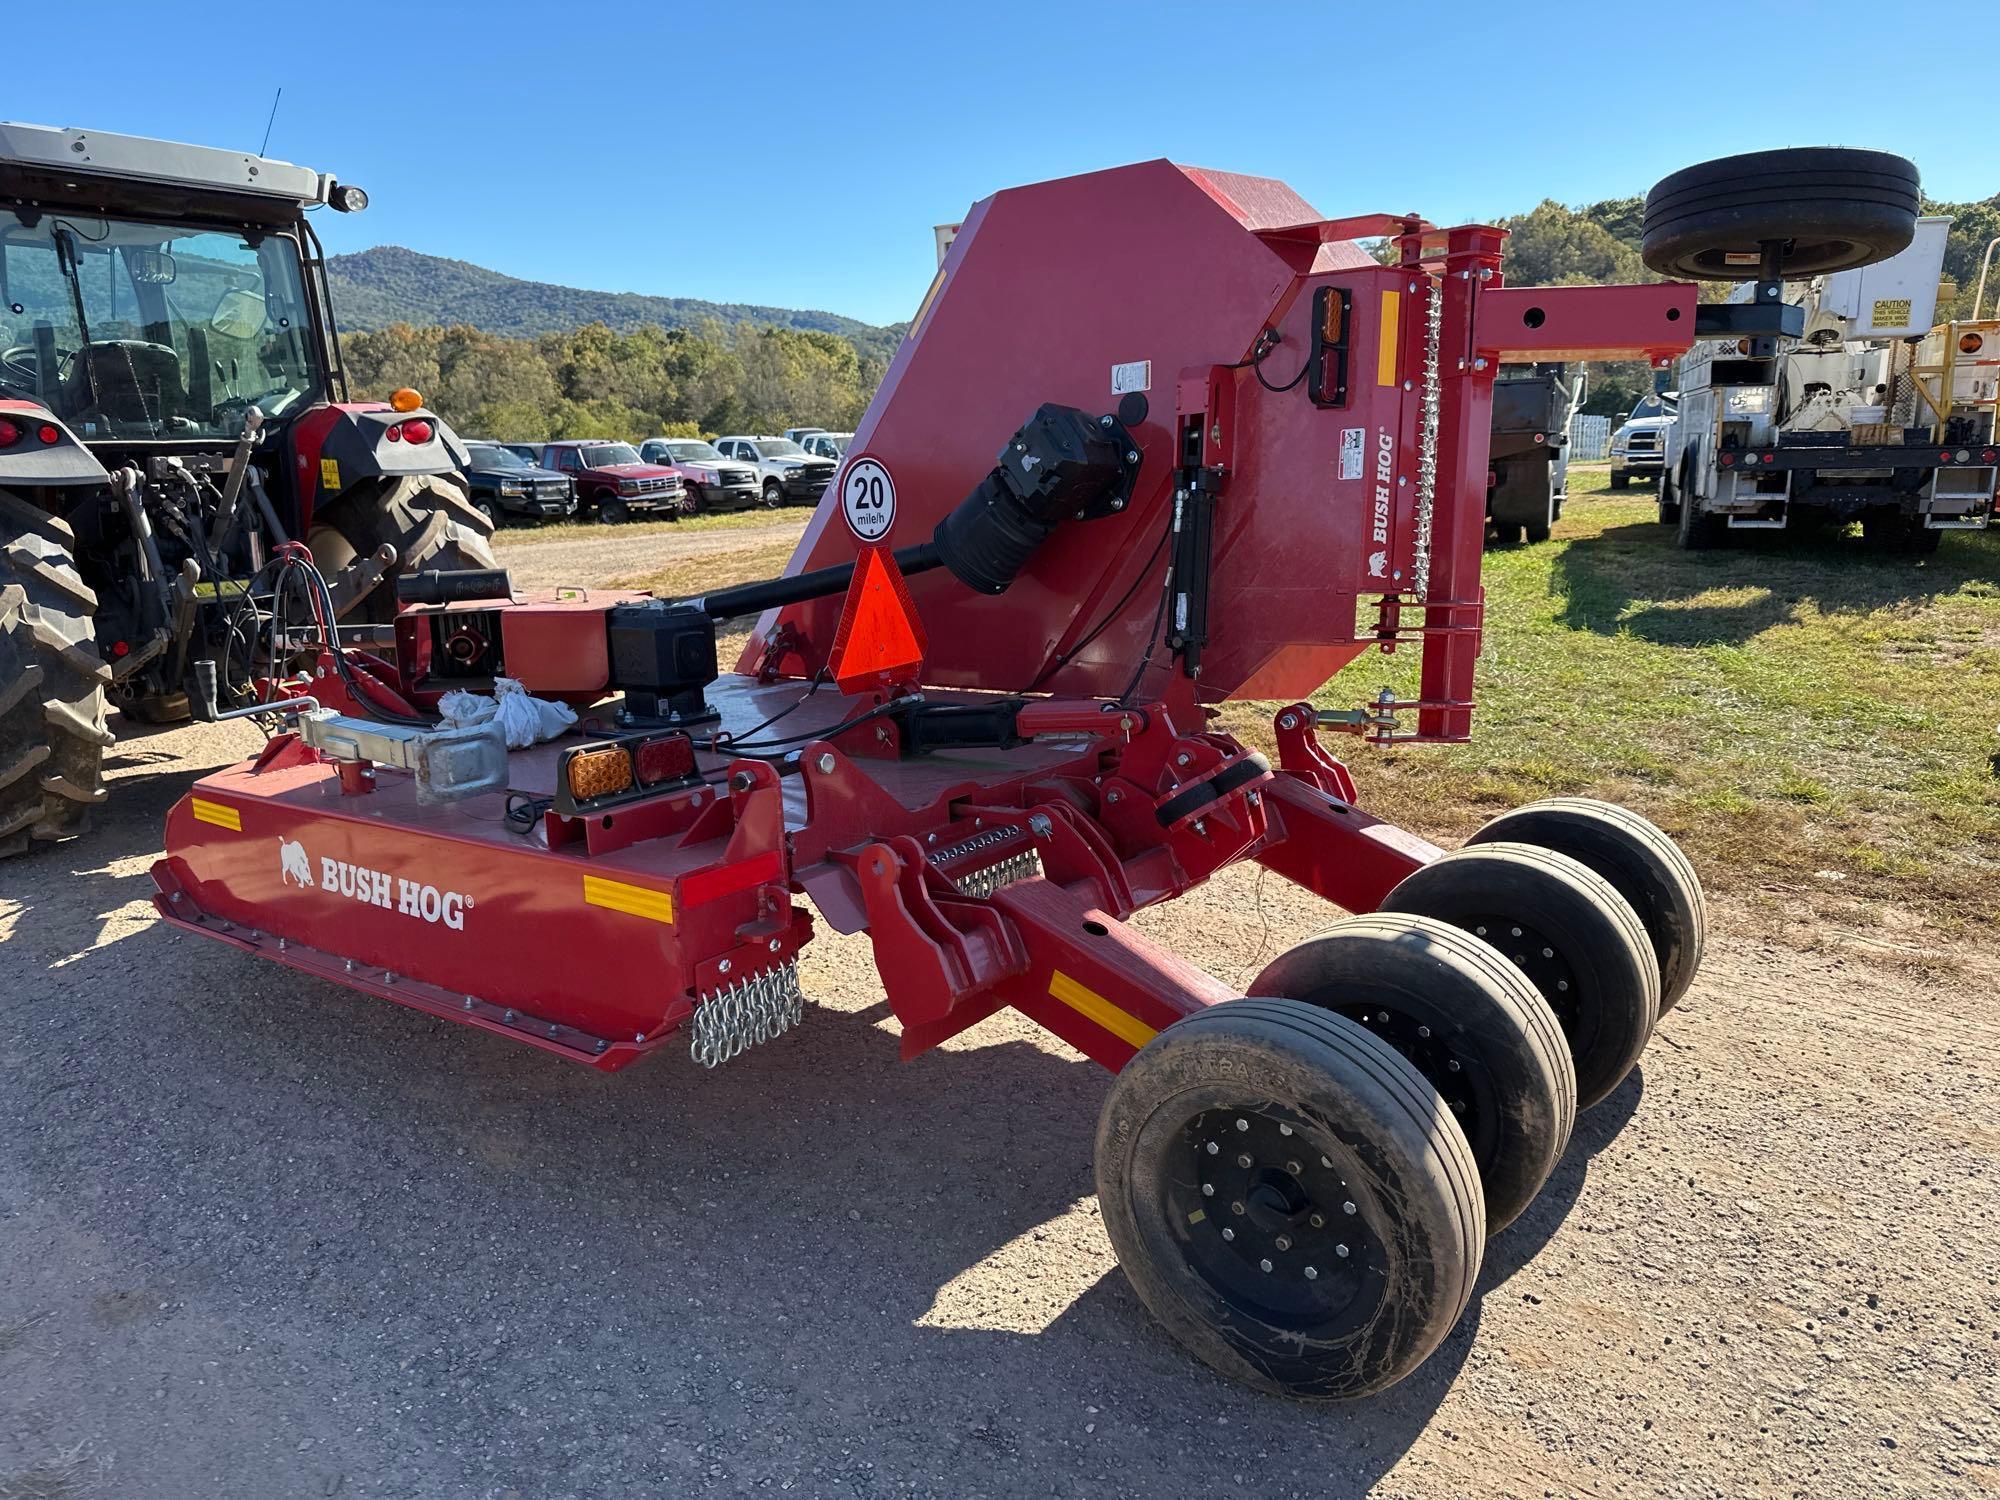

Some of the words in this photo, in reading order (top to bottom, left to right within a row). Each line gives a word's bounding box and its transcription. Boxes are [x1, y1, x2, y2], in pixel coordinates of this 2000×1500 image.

[1874, 300, 1911, 309] CAUTION
[854, 476, 884, 509] 20
[857, 513, 885, 525] mile/h
[1373, 485, 1390, 544] BUSH
[321, 856, 393, 909] BUSH
